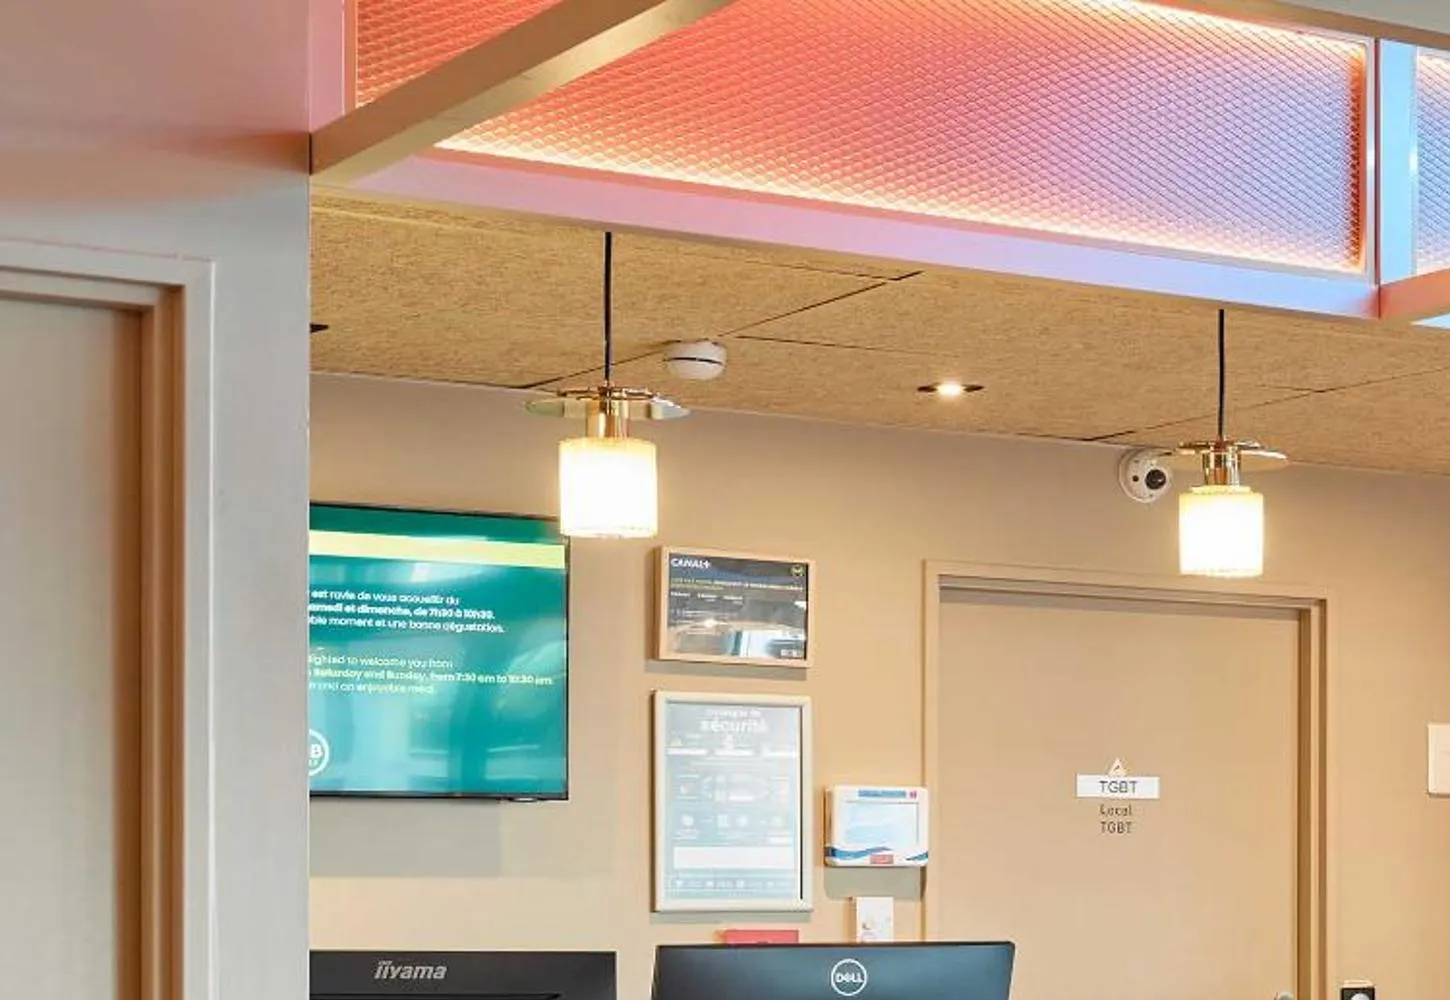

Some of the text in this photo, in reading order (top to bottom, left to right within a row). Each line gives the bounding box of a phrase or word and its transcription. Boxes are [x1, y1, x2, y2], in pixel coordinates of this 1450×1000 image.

[671, 558, 711, 569] CANAL+
[357, 589, 371, 600] de
[372, 593, 397, 602] vous
[308, 602, 343, 612] amedi
[1099, 780, 1137, 793] TGBT
[1100, 803, 1133, 816] Local
[1100, 821, 1132, 834] TGBT
[374, 960, 448, 979] iiyama
[836, 972, 864, 982] DELL
